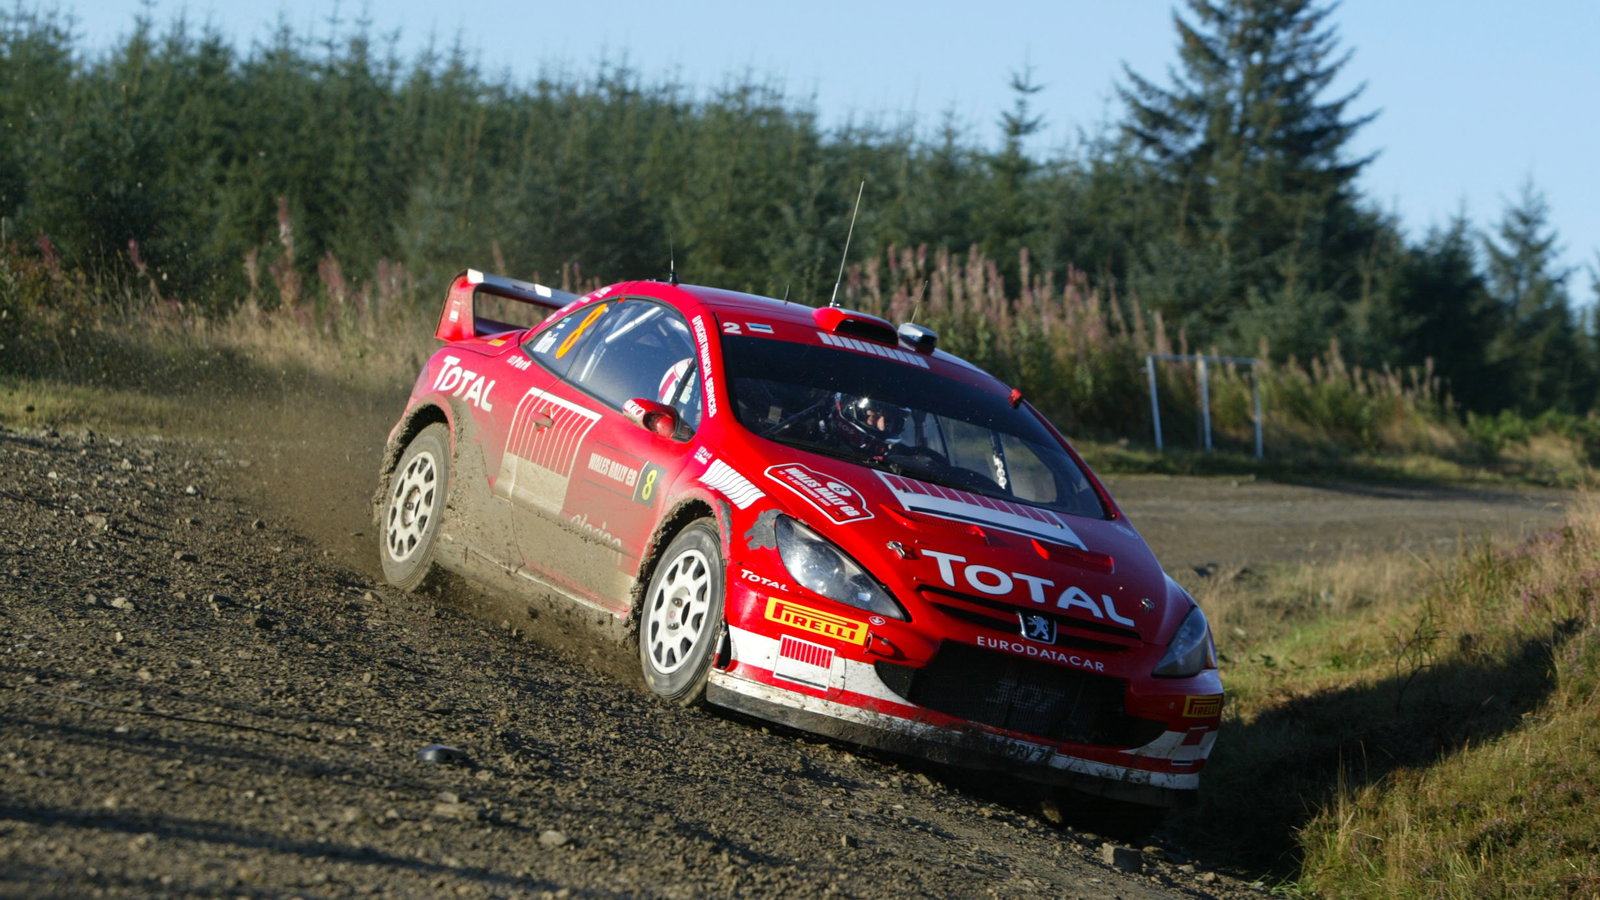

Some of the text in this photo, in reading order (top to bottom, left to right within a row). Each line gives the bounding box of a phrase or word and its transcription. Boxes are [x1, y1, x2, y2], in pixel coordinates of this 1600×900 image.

[556, 304, 607, 359] 8
[722, 322, 742, 335] 2
[700, 343, 712, 380] FINANCIAL
[433, 355, 496, 413] TOTAL
[705, 377, 718, 419] SERVICES
[588, 452, 639, 487] WALES RALLY GB
[641, 470, 658, 500] 8
[785, 467, 860, 517] WALES RALLY GB
[740, 569, 790, 592] TOTAL
[921, 549, 1135, 628] TOTAL
[773, 600, 860, 641] PIRELLI
[976, 636, 1105, 672] EURODATACAR
